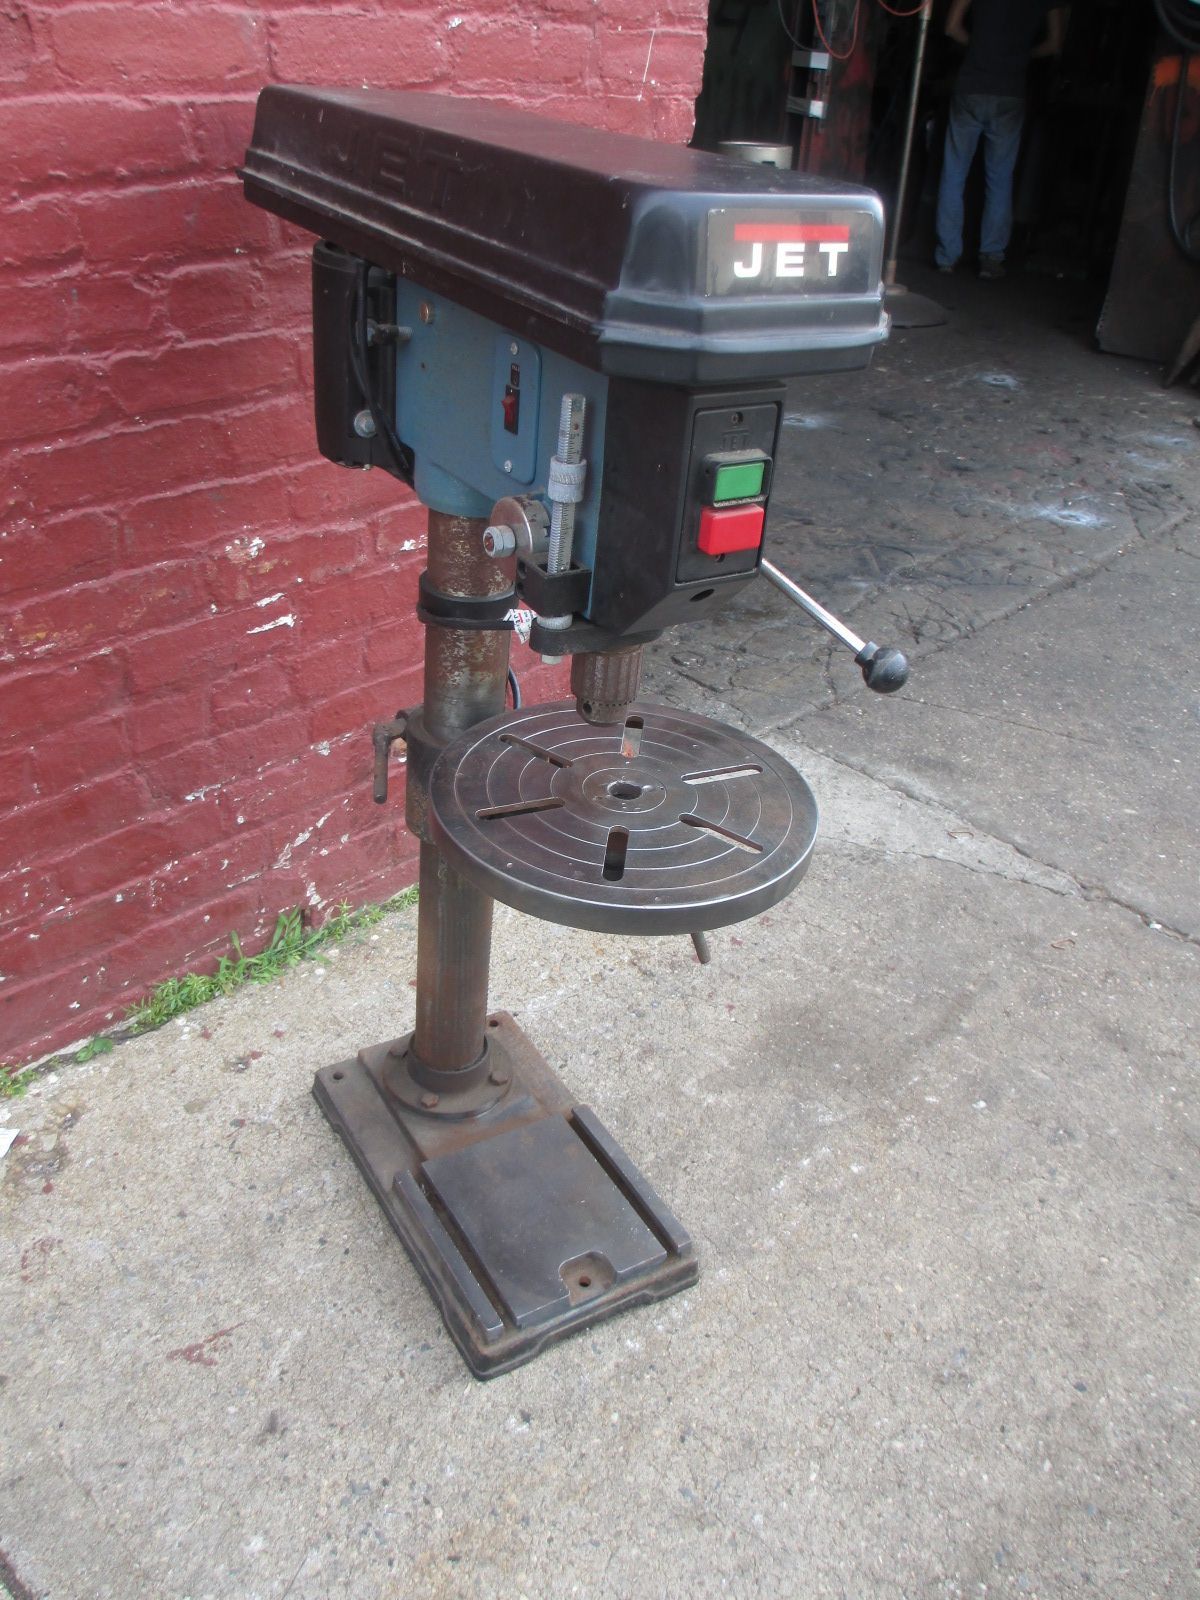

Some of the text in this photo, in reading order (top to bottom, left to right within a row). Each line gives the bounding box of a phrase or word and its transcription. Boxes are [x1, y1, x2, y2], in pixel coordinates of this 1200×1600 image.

[329, 127, 462, 209] JET
[733, 242, 848, 278] JET
[720, 434, 750, 450] JET
